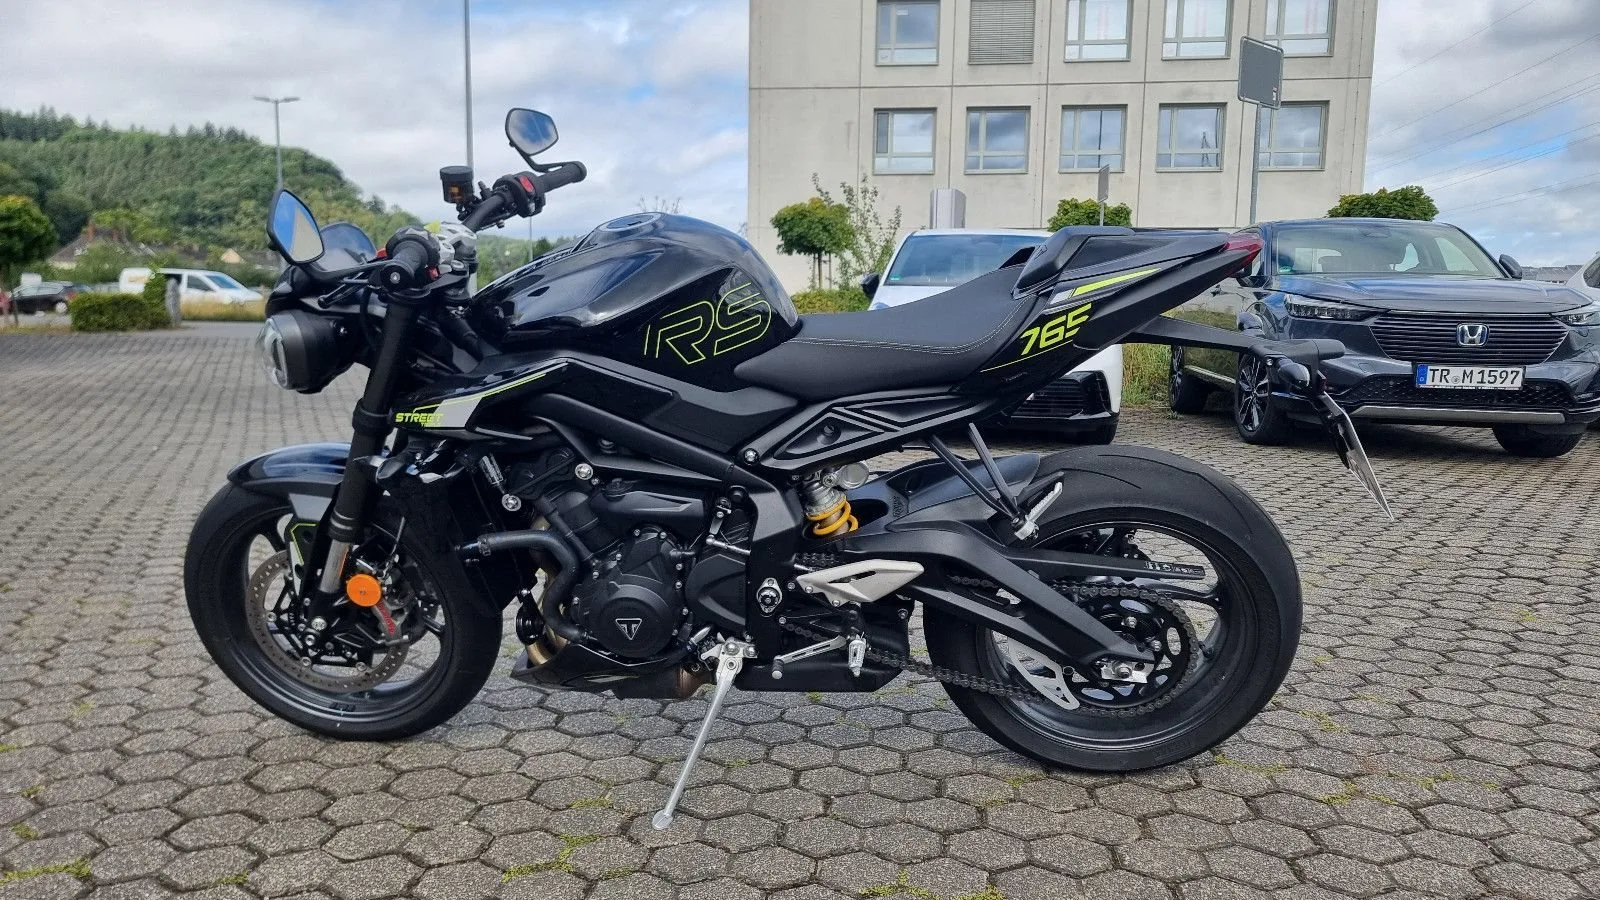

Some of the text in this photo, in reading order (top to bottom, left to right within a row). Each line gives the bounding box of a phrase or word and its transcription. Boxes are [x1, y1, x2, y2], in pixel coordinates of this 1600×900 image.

[644, 282, 772, 365] RS
[1020, 303, 1092, 356] 765
[1429, 368, 1450, 383] TR
[1461, 369, 1474, 384] M
[1477, 370, 1520, 385] 1597
[395, 412, 444, 423] STREET
